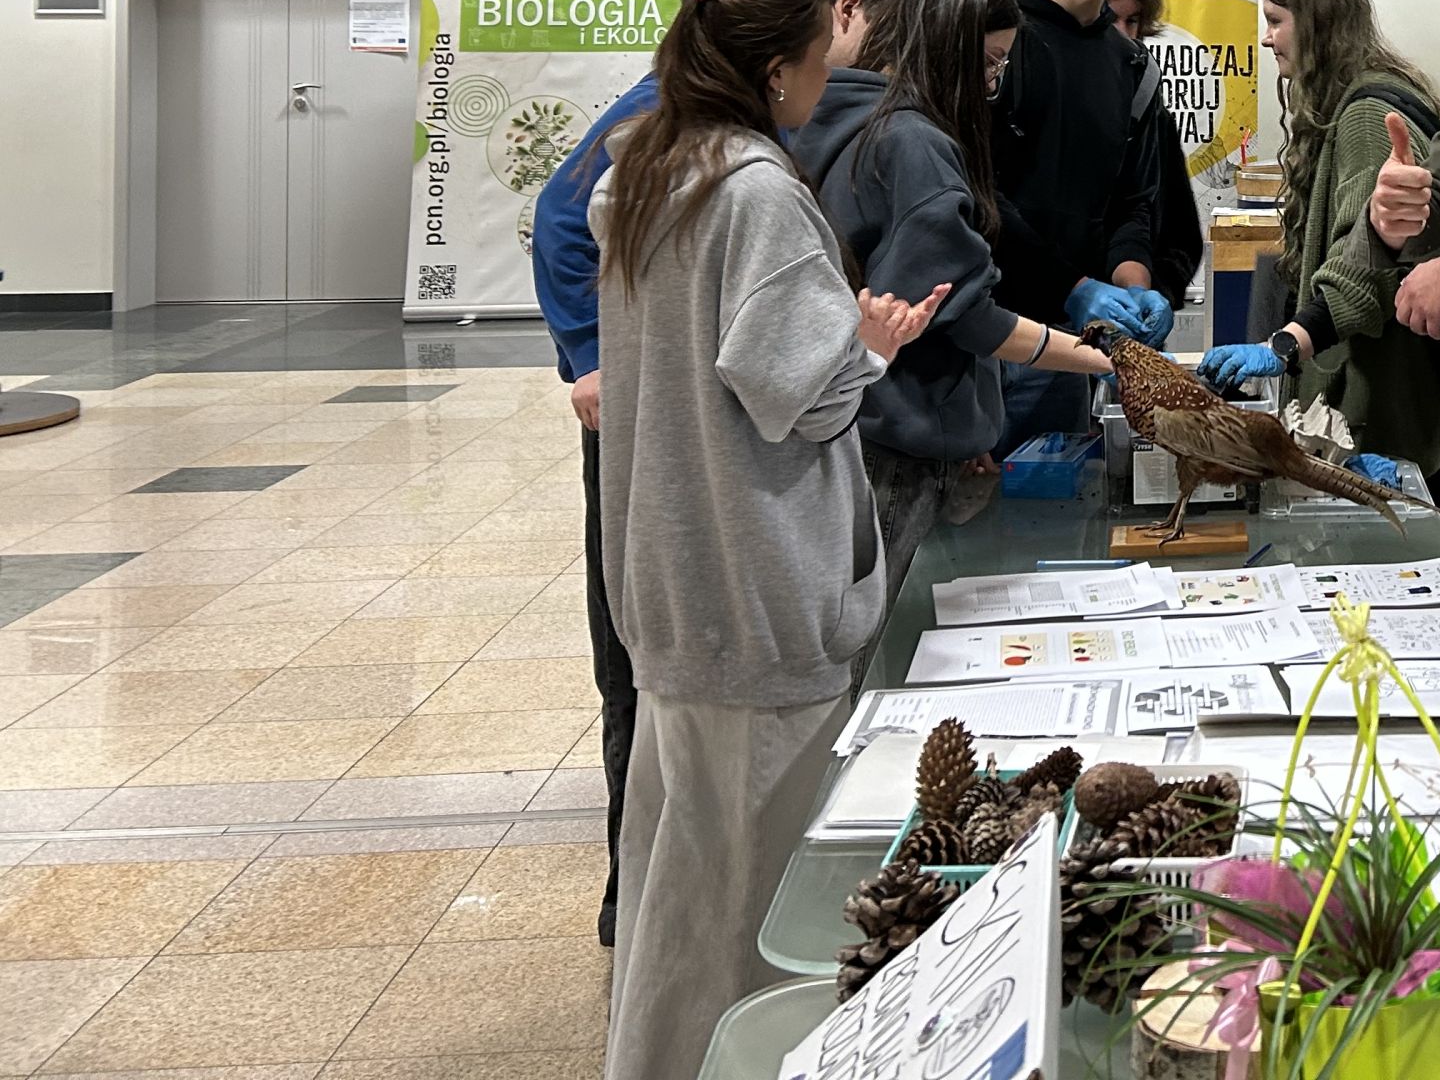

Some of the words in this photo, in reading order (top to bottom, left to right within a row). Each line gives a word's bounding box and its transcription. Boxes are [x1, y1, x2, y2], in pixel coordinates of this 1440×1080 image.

[579, 27, 586, 45] i
[1162, 78, 1220, 110] ORUJ
[425, 33, 455, 245] pcn.org.pl/biologia
